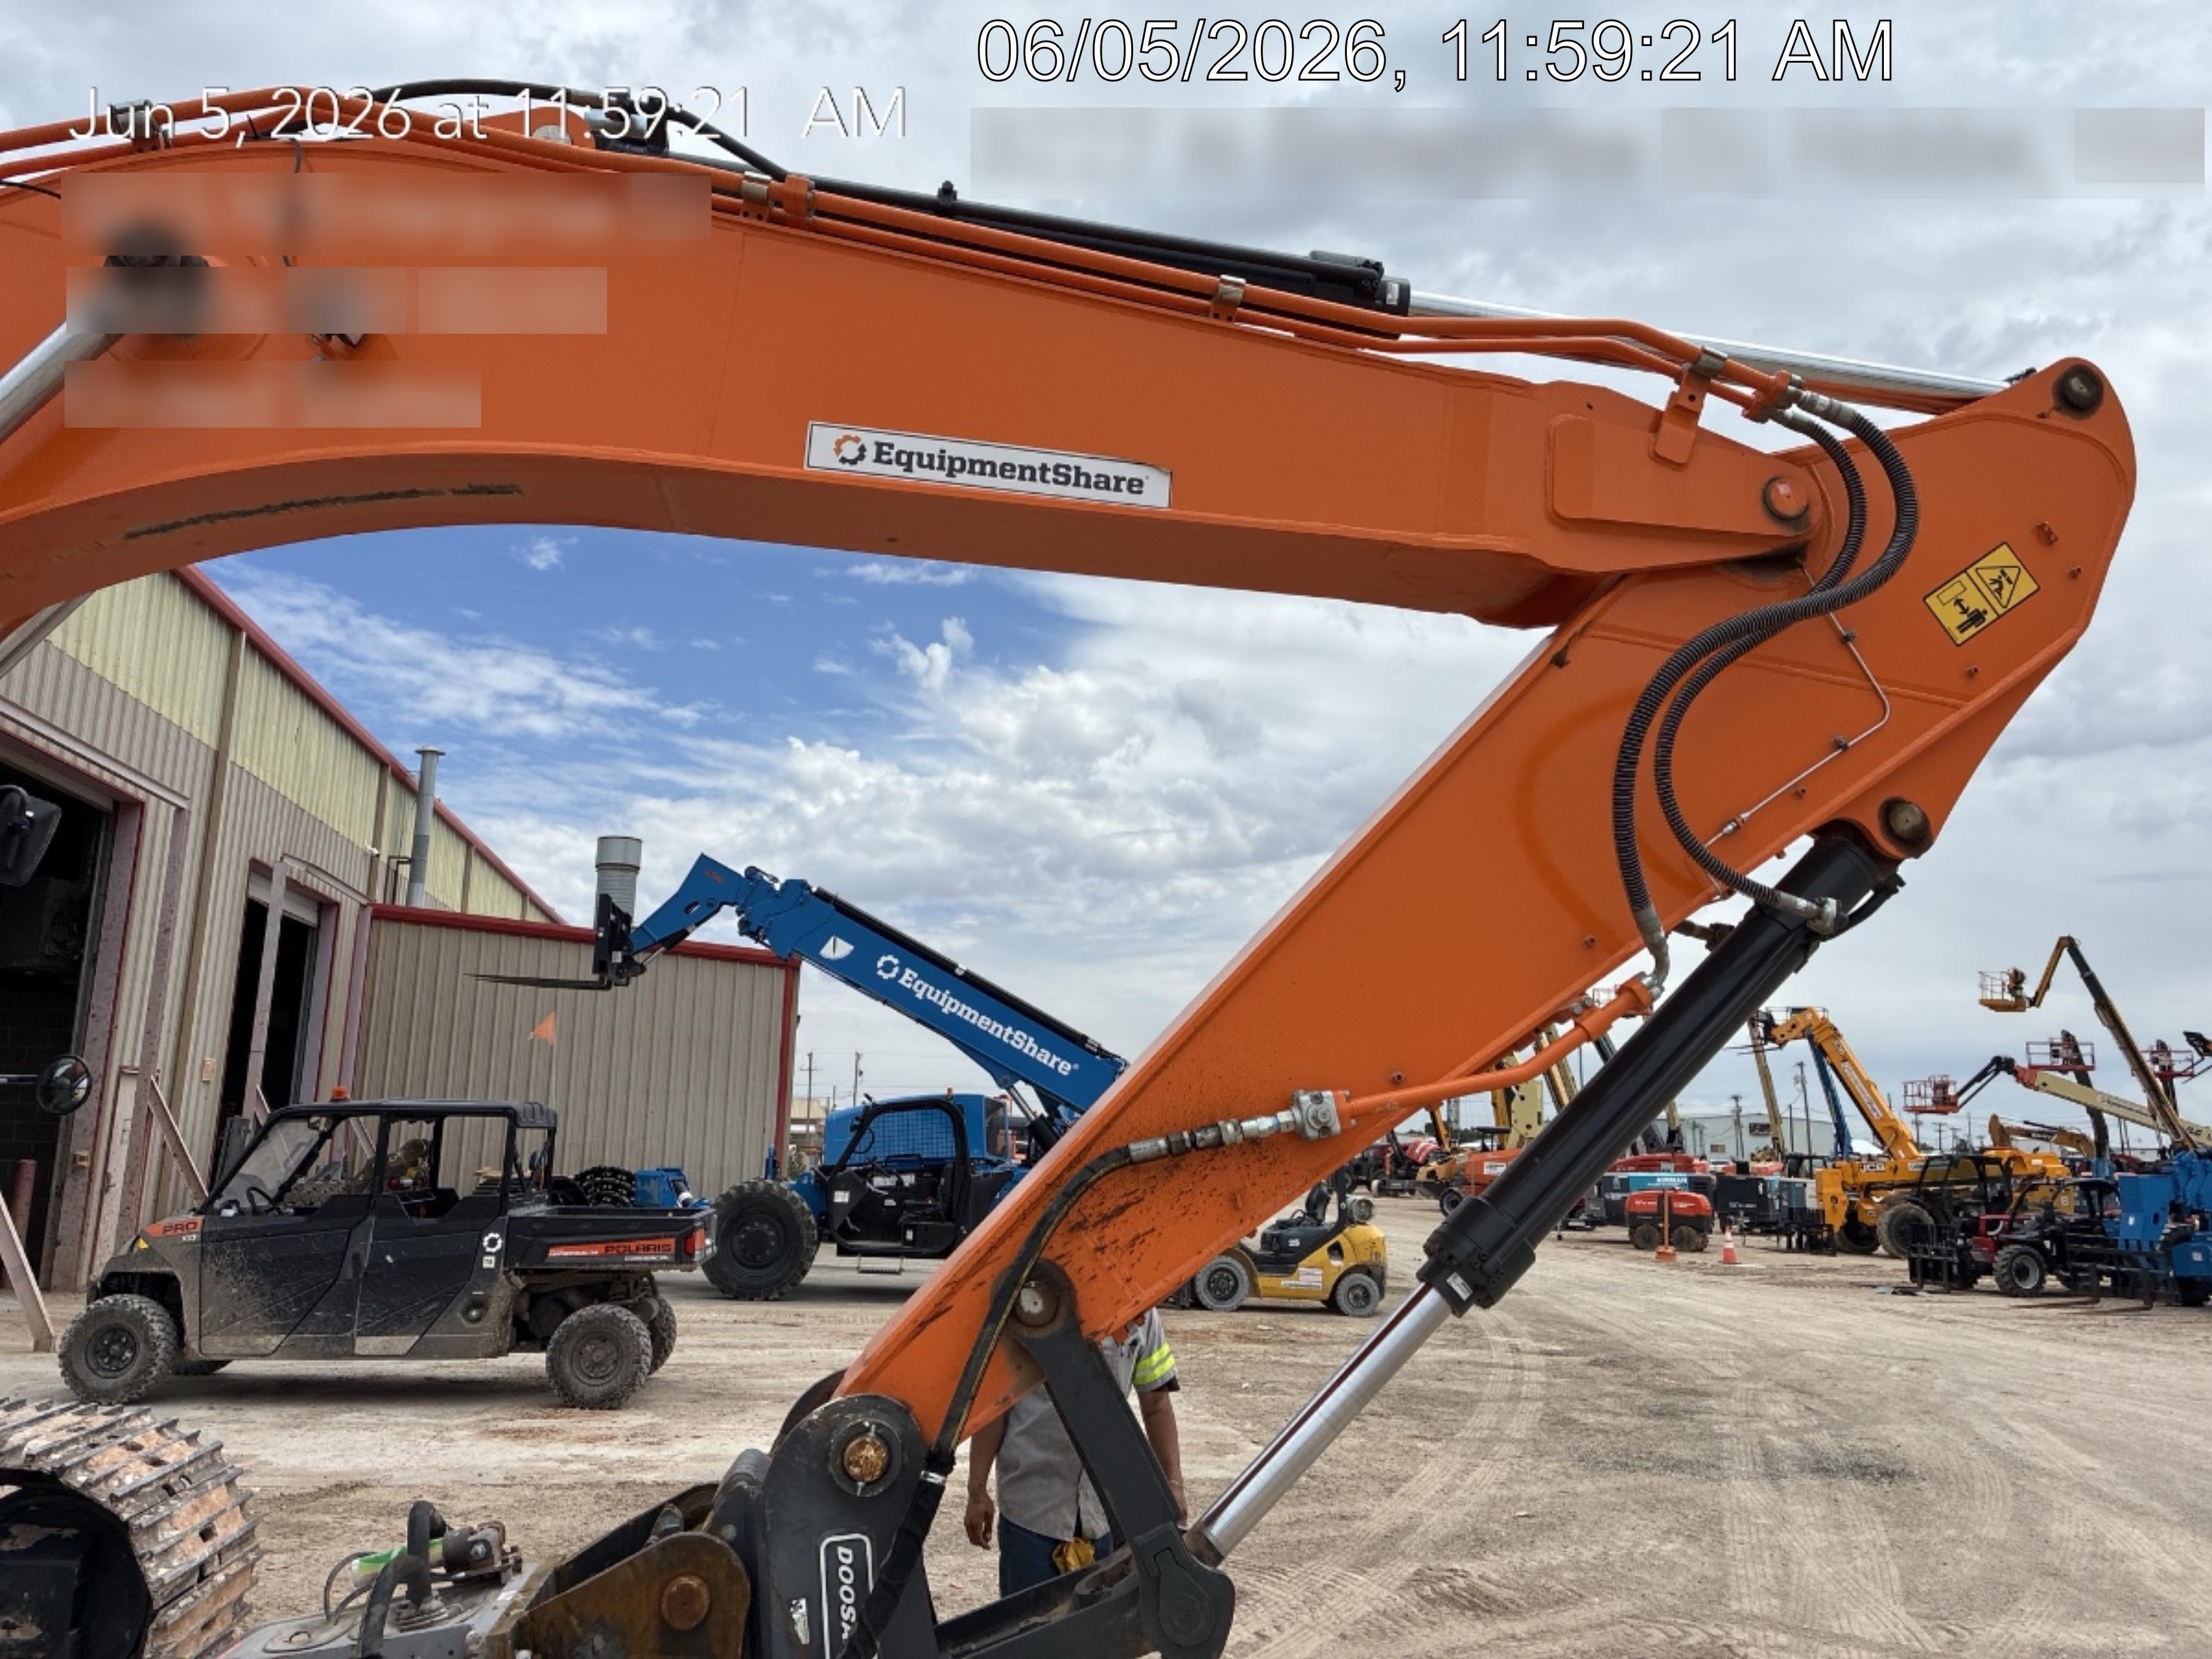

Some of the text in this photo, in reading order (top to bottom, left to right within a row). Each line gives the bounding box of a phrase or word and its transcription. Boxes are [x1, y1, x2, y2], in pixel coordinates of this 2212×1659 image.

[872, 441, 1145, 495] EquipmentShare
[897, 967, 1073, 1076] EquipmentShare
[162, 1222, 198, 1234] PRO
[605, 1244, 672, 1255] POLARIS
[836, 1545, 857, 1640] DOOSA
